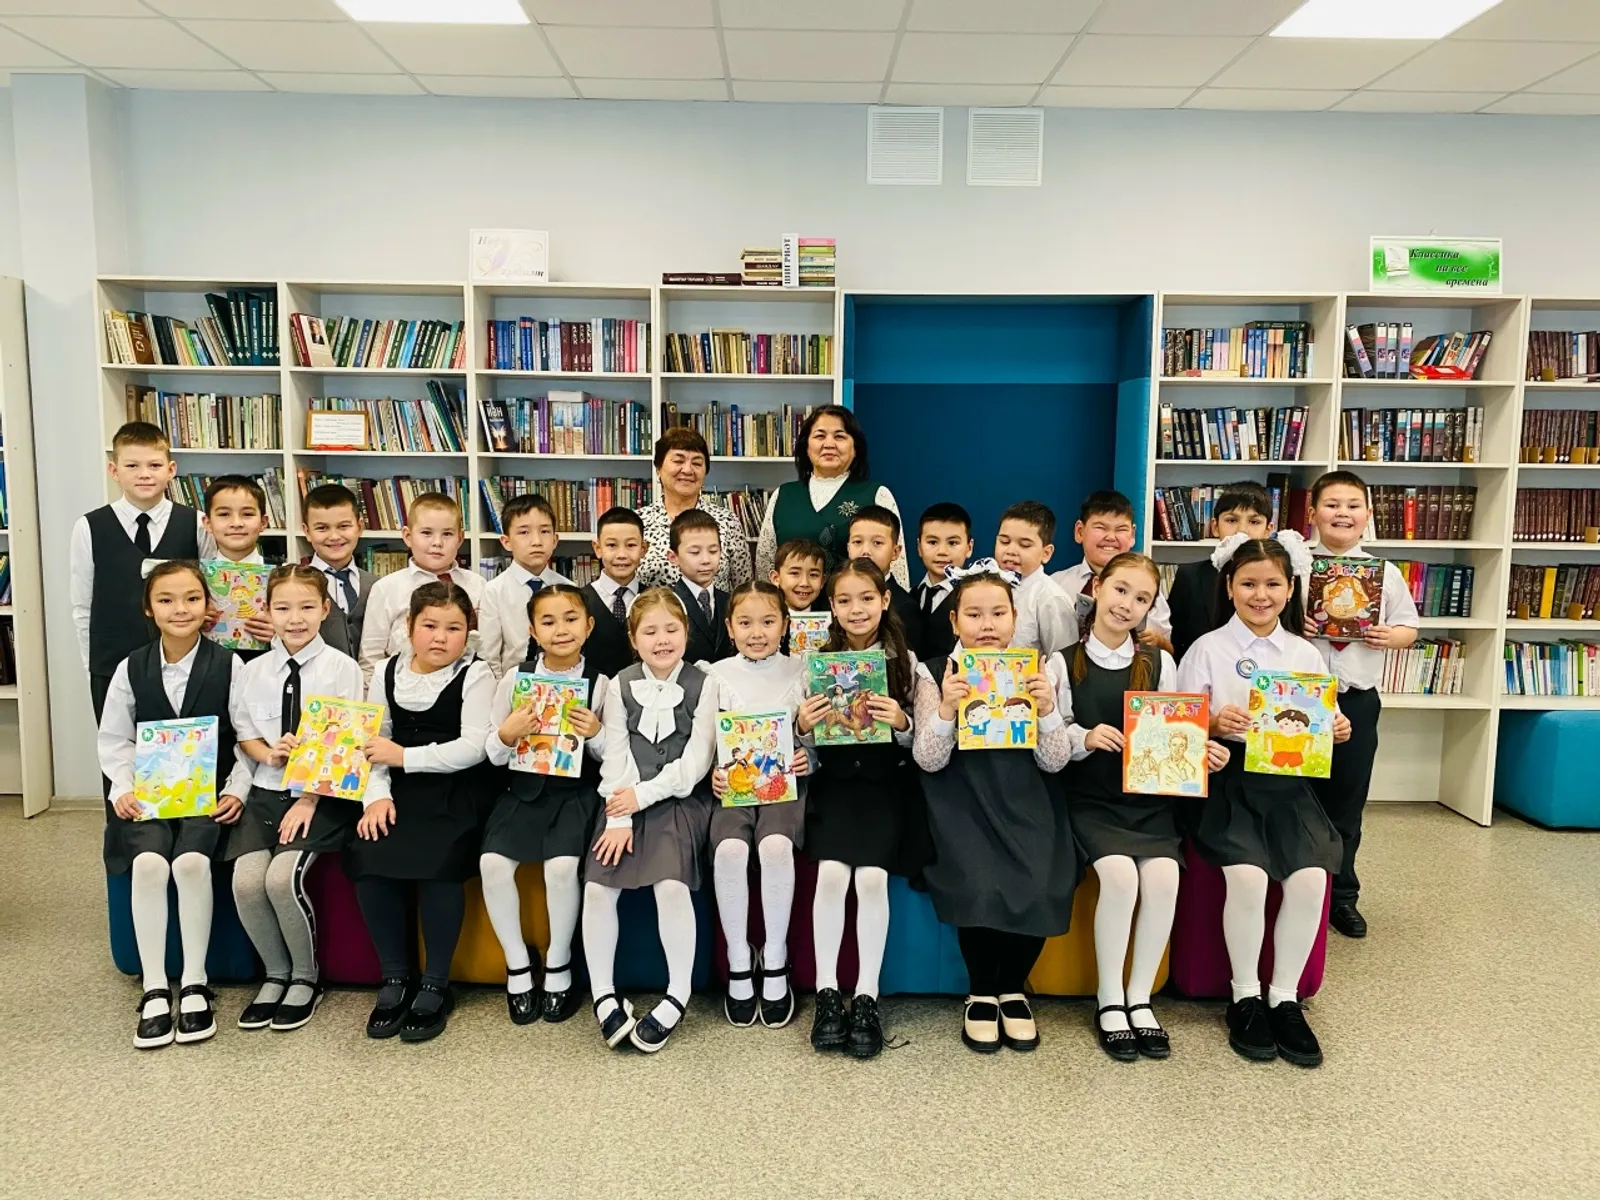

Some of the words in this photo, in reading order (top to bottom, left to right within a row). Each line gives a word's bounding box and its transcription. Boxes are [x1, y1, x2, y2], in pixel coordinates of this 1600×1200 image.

[1410, 248, 1460, 259] Классика
[1451, 265, 1468, 273] все
[1446, 278, 1489, 288] времена
